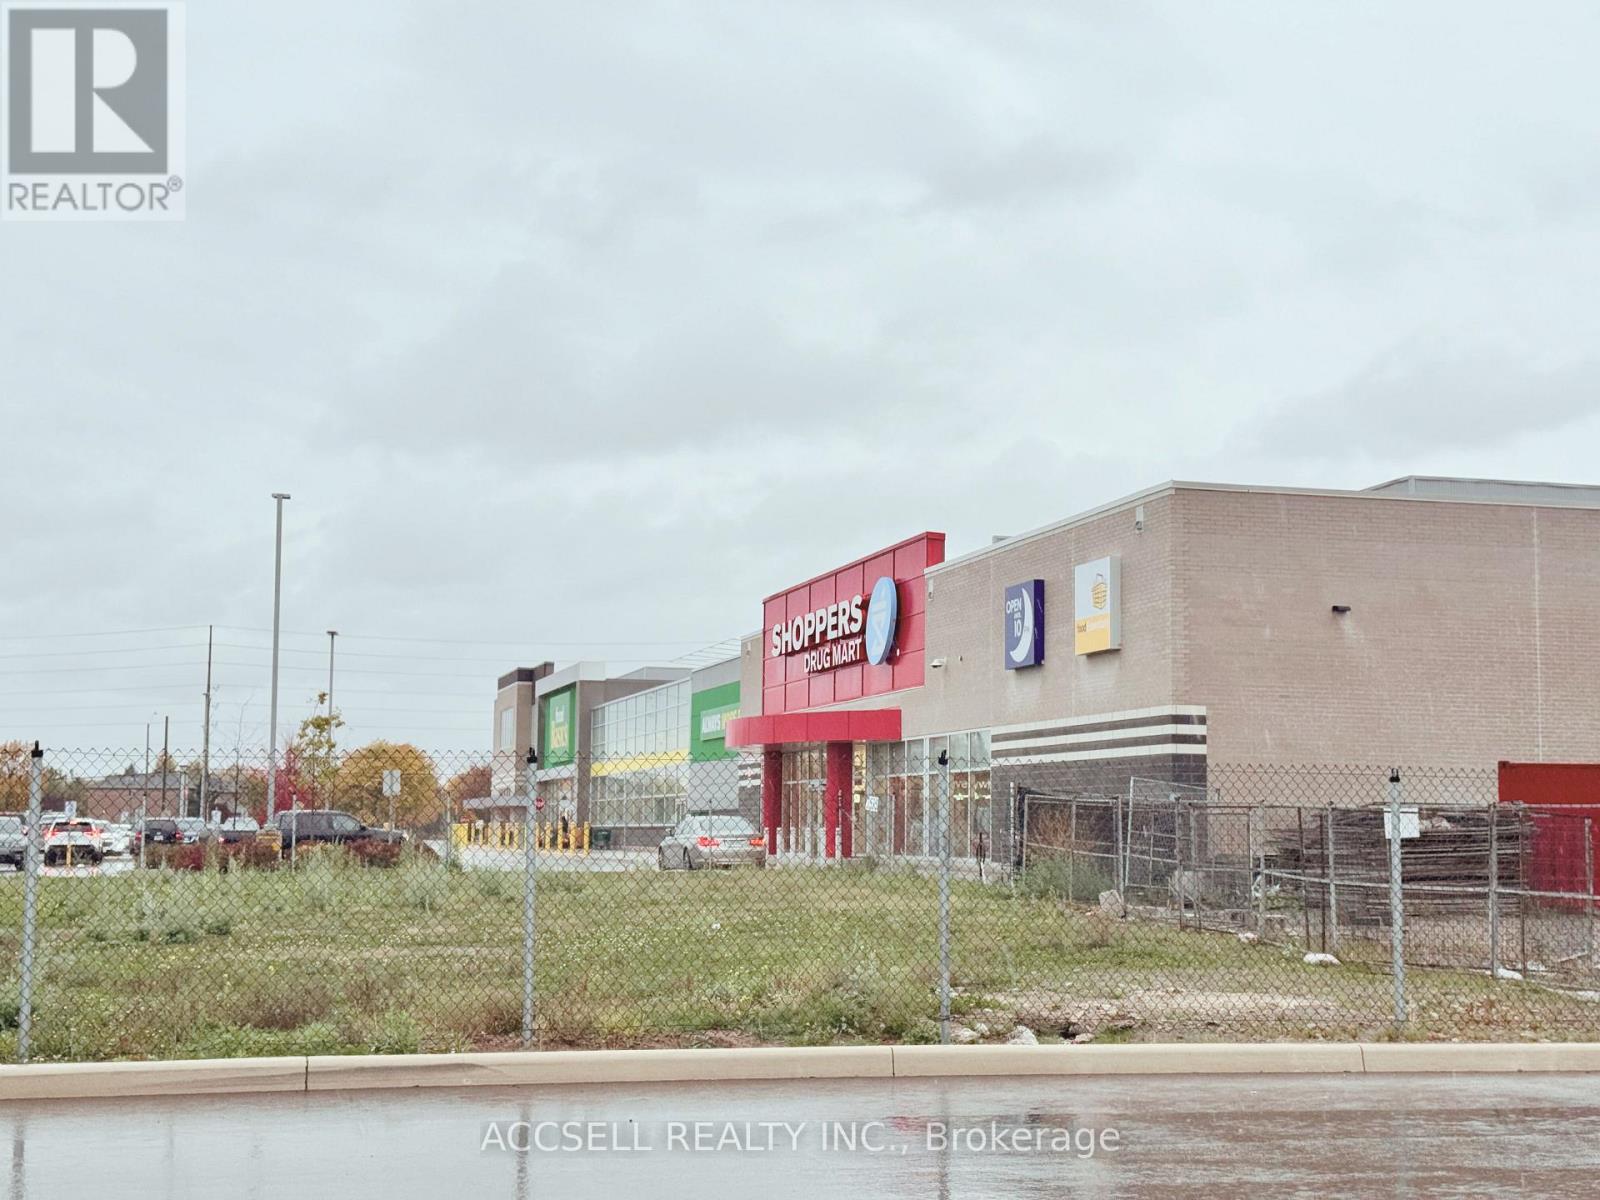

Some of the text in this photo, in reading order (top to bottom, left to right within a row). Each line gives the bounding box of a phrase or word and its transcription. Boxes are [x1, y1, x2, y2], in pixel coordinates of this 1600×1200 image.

[1006, 597, 1022, 614] OPEN
[771, 594, 863, 657] SHOPPERS
[1014, 619, 1022, 638] 10
[803, 637, 862, 673] DRUG MART
